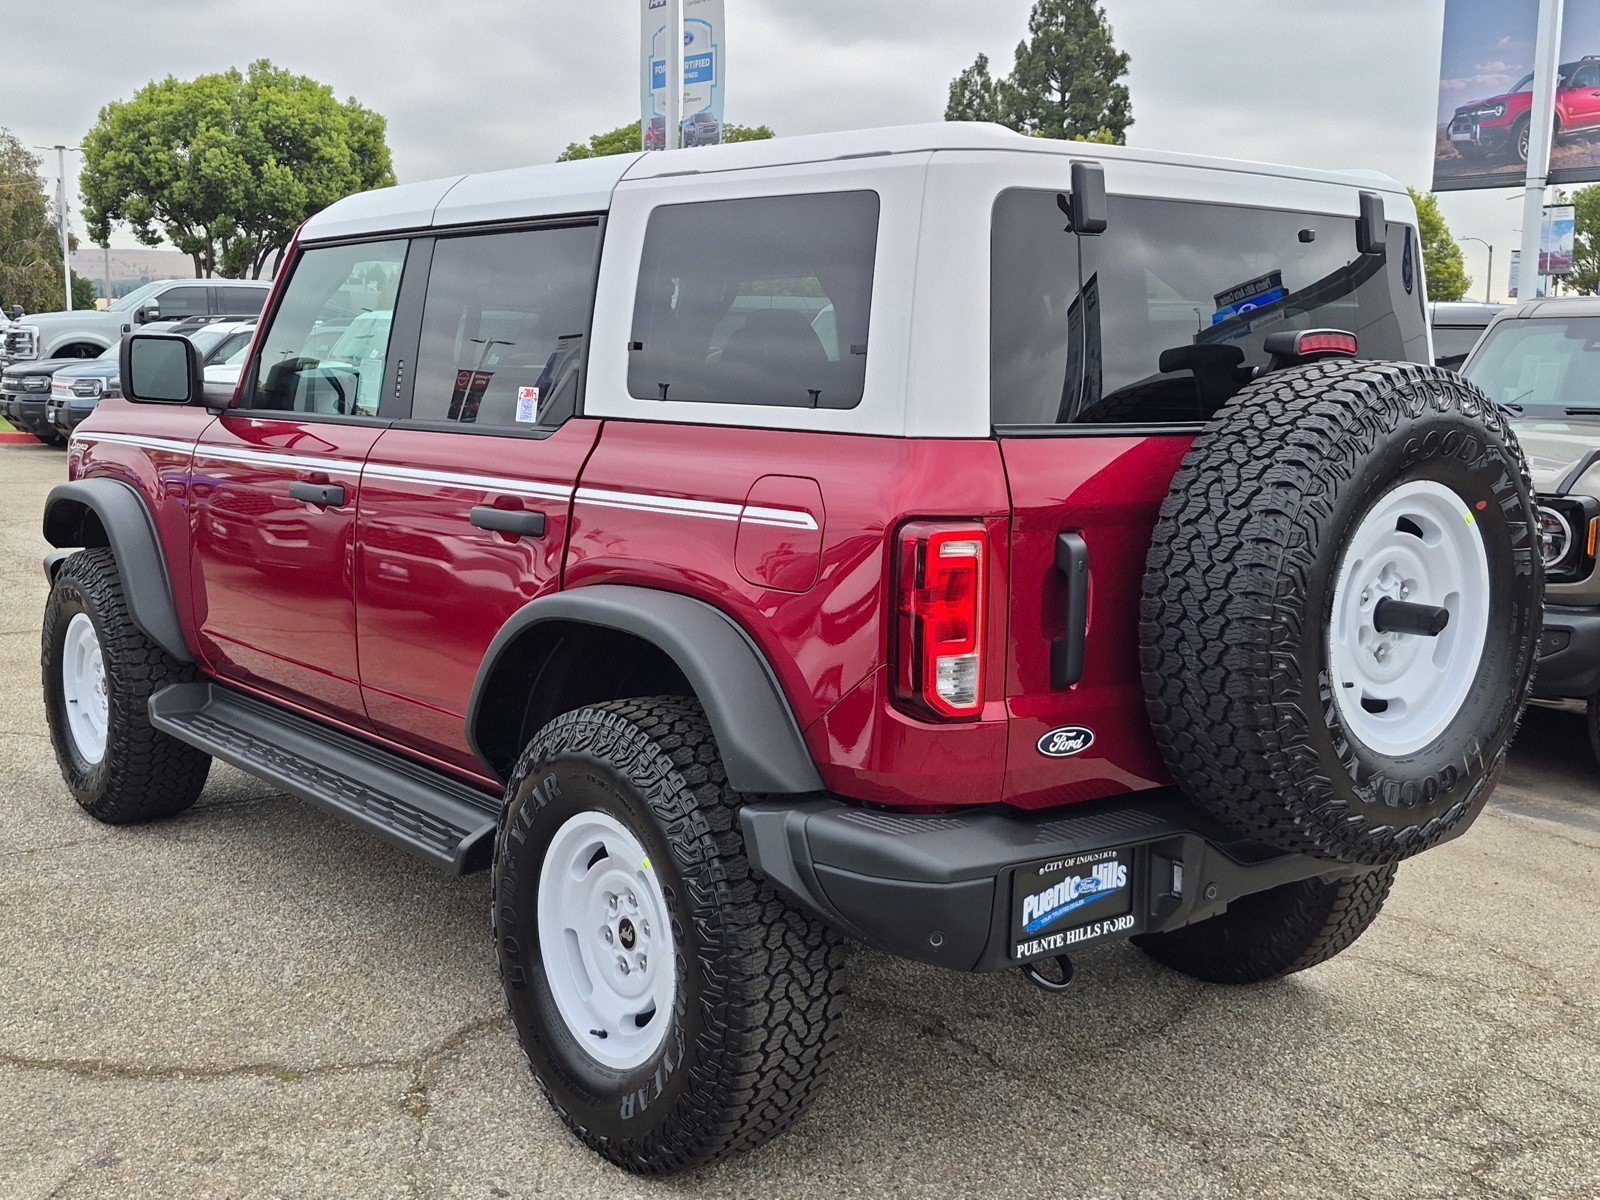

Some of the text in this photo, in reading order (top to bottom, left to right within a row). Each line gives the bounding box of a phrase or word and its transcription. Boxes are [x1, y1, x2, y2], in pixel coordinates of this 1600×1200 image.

[523, 388, 534, 397] 3M
[1045, 729, 1089, 754] Ford
[1044, 850, 1112, 872] CITY OF INDUSTRY
[1022, 875, 1081, 927] Puente
[1091, 861, 1127, 892] Hills
[1016, 915, 1135, 958] PUENTE HILLS FORD
